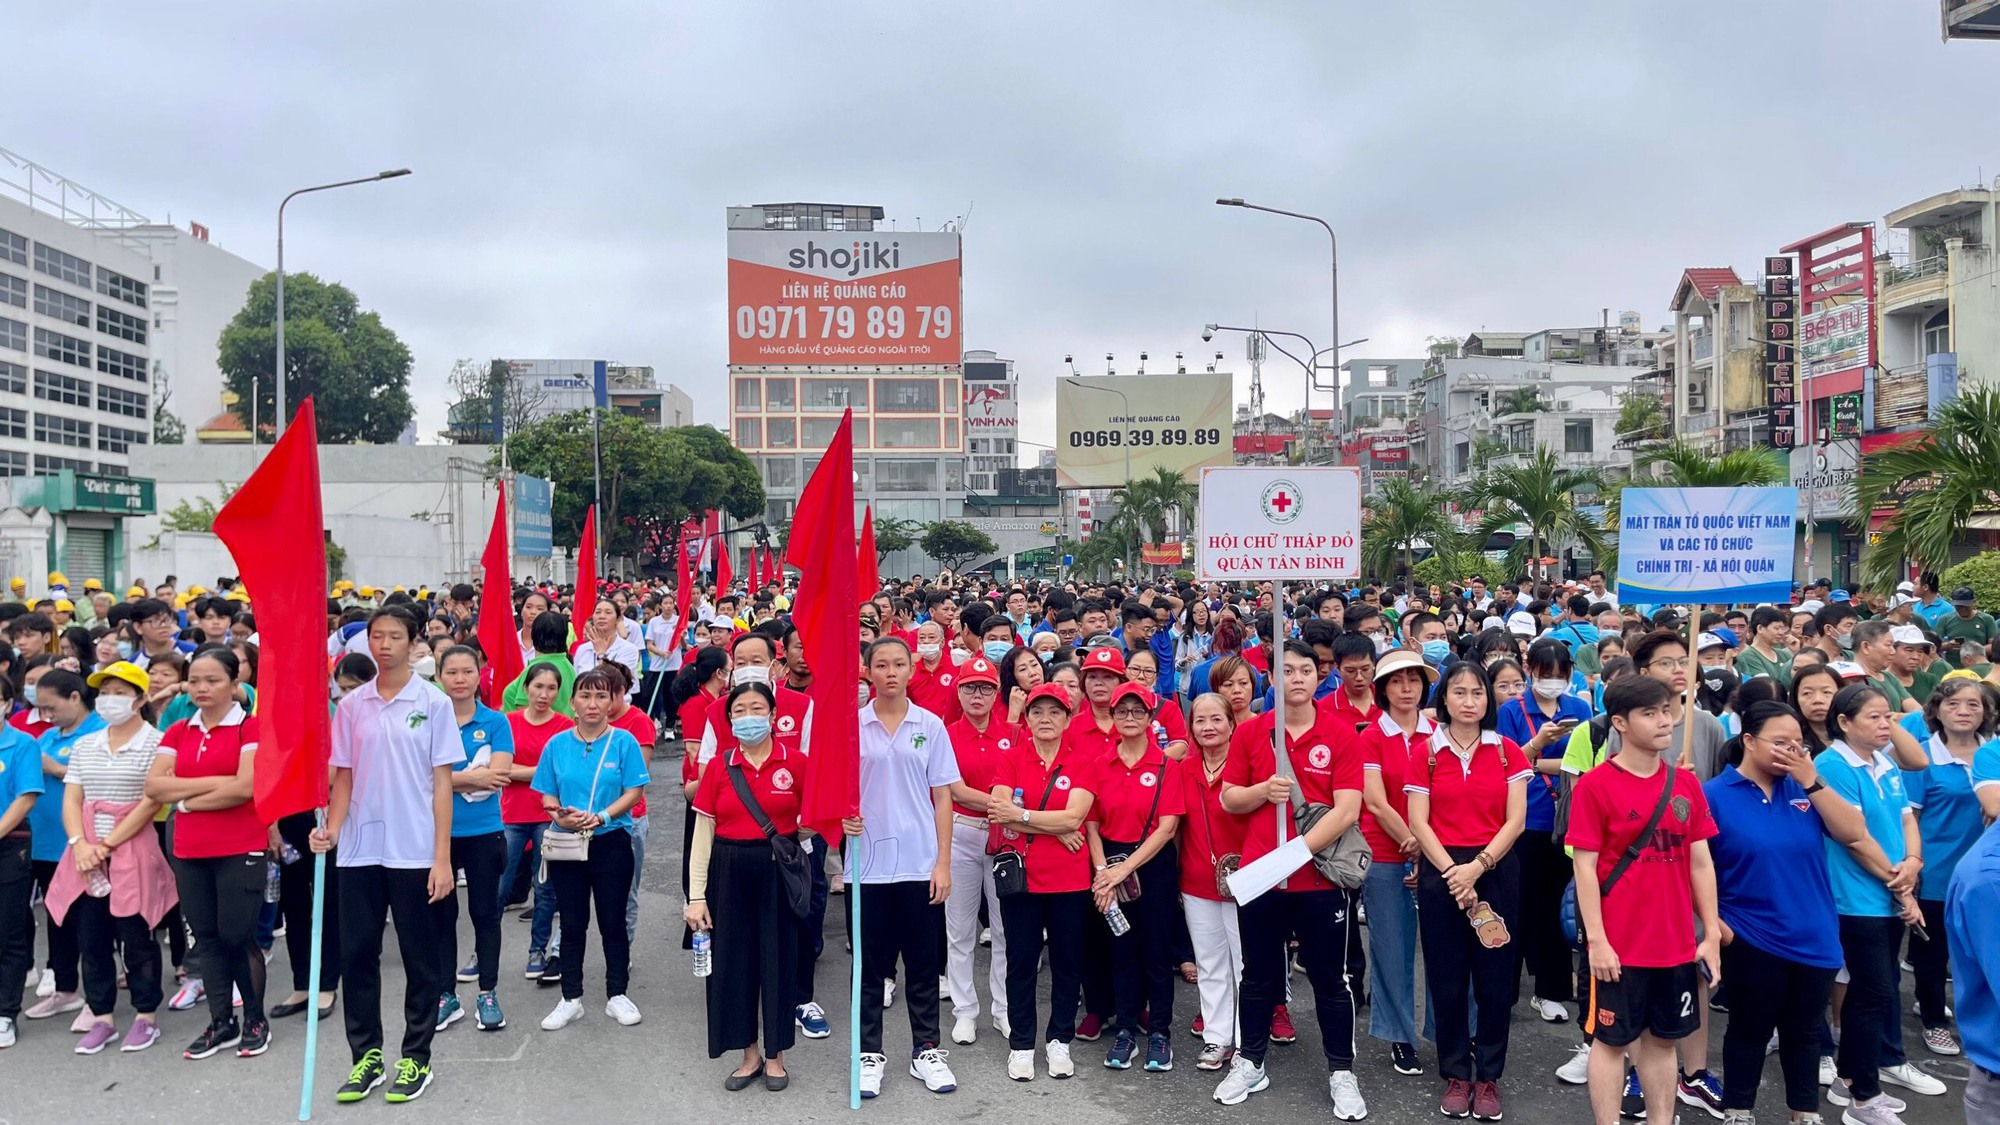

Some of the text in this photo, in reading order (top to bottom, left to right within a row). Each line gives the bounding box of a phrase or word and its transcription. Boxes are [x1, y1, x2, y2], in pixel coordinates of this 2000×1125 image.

[788, 240, 900, 277] shojiki
[782, 281, 906, 301] LIÊN HỆ QUẢNG CÁO
[736, 305, 951, 339] 0971 79 89 79
[759, 343, 786, 355] HÀNG
[823, 342, 856, 356] QUẢNG
[857, 342, 877, 355] CÁO
[878, 342, 908, 355] NGOÀI
[909, 342, 931, 355] TRỜI
[968, 417, 1015, 427] VINH AN
[1108, 414, 1125, 424] LIÊN
[1138, 413, 1164, 424] QUẢNG
[1165, 413, 1181, 423] CÁO
[1069, 428, 1220, 447] 0969.39.89.89
[993, 521, 1037, 531] Amazon
[1653, 513, 1682, 532] TRẬN
[1685, 511, 1699, 529] TỔ
[1702, 510, 1734, 530] QUỐC
[1737, 513, 1762, 532] VIỆT
[1765, 515, 1791, 529] NAM
[1208, 531, 1354, 551] HỘI CHỮ THẬP ĐỎ
[1660, 533, 1753, 551] VÀ CÁC TỔ CHỨC
[1217, 553, 1345, 573] QUẬN TÂN BÌNH
[1636, 558, 1671, 573] CHÍNH
[1674, 559, 1693, 575] TRỊ
[1703, 557, 1718, 573] XÃ
[1721, 557, 1741, 575] HỘI
[1744, 557, 1775, 575] QUẬN
